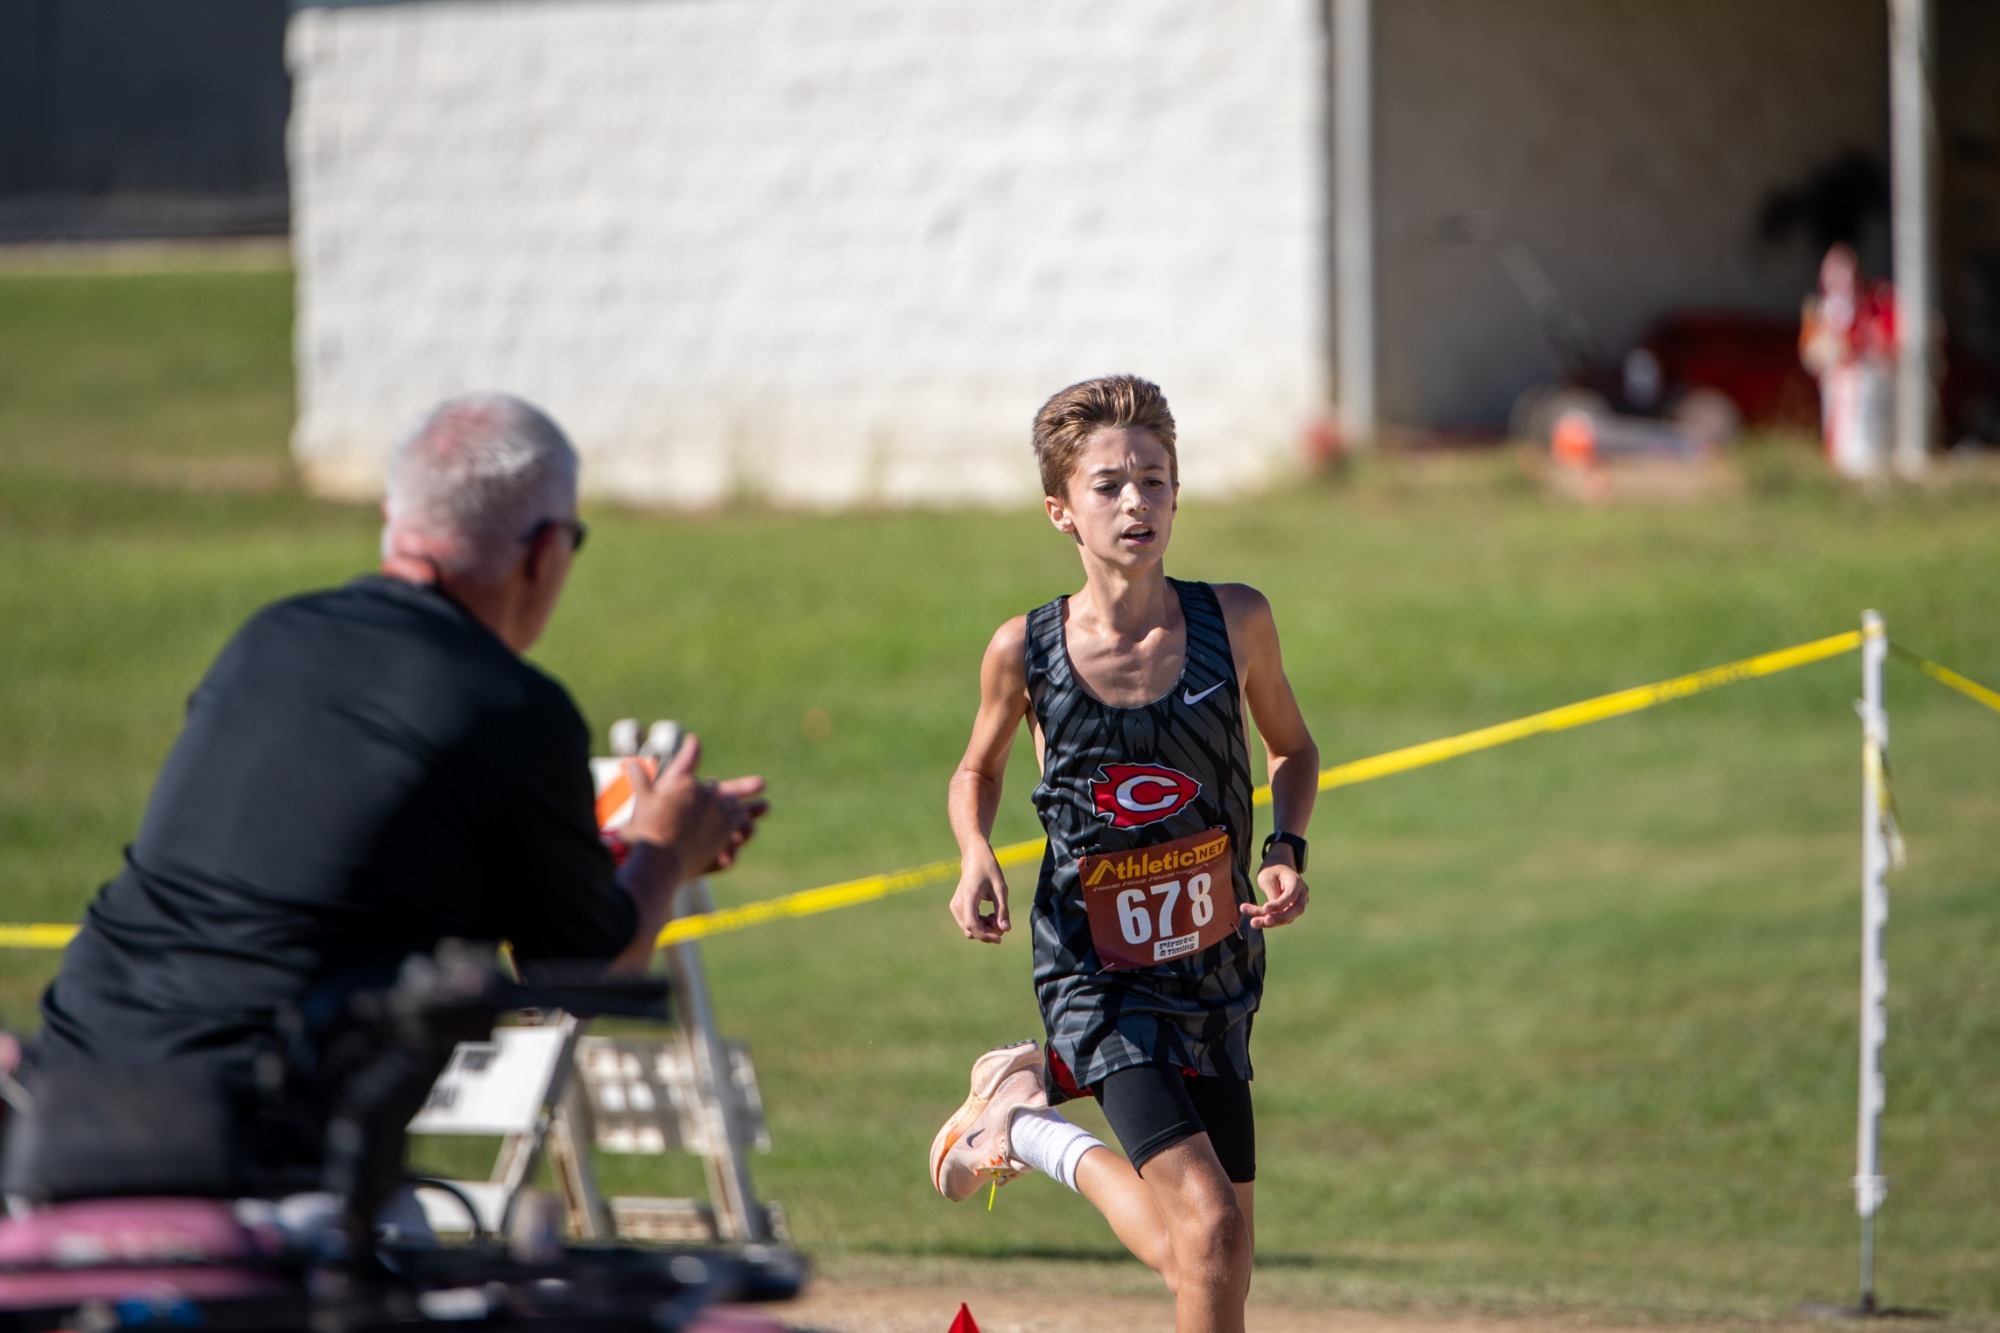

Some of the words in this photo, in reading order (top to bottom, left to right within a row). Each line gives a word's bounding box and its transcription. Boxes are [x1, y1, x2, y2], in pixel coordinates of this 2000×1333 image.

[1116, 775, 1180, 812] C
[1116, 872, 1214, 945] 678
[1159, 935, 1195, 950] Pirate
[1167, 942, 1195, 956] Timing
